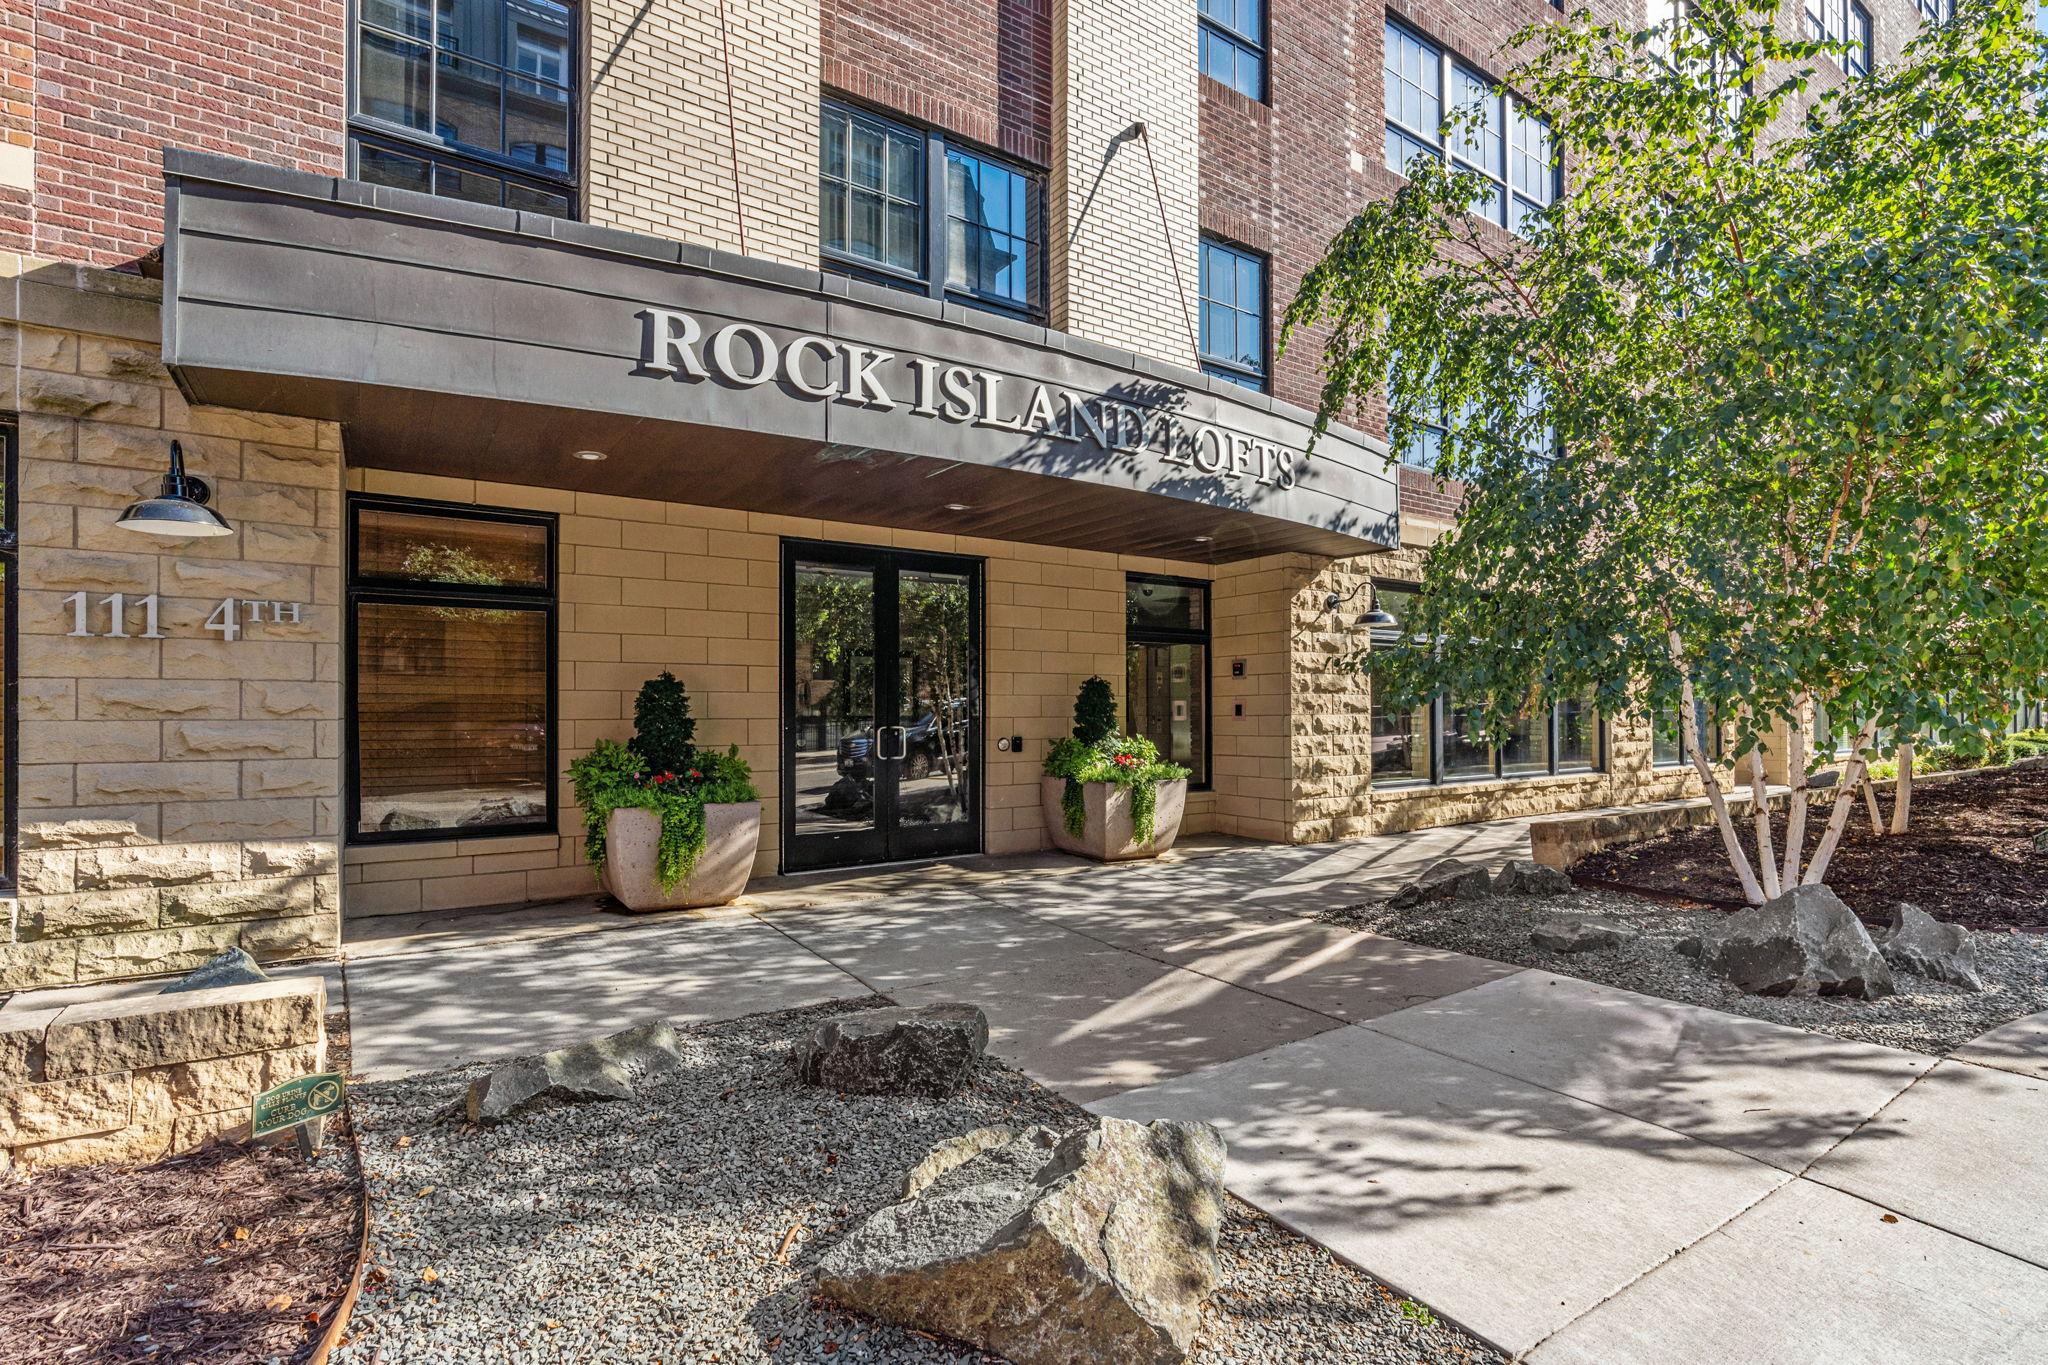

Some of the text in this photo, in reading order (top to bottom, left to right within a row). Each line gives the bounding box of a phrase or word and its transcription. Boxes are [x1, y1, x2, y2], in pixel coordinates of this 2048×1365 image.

[645, 308, 1296, 490] ROCK ISLAND LOFTS
[63, 591, 301, 641] 111 4TH
[266, 1094, 280, 1103] DOG
[259, 1107, 307, 1128] YOUR DOG
[270, 1103, 296, 1117] CURB
